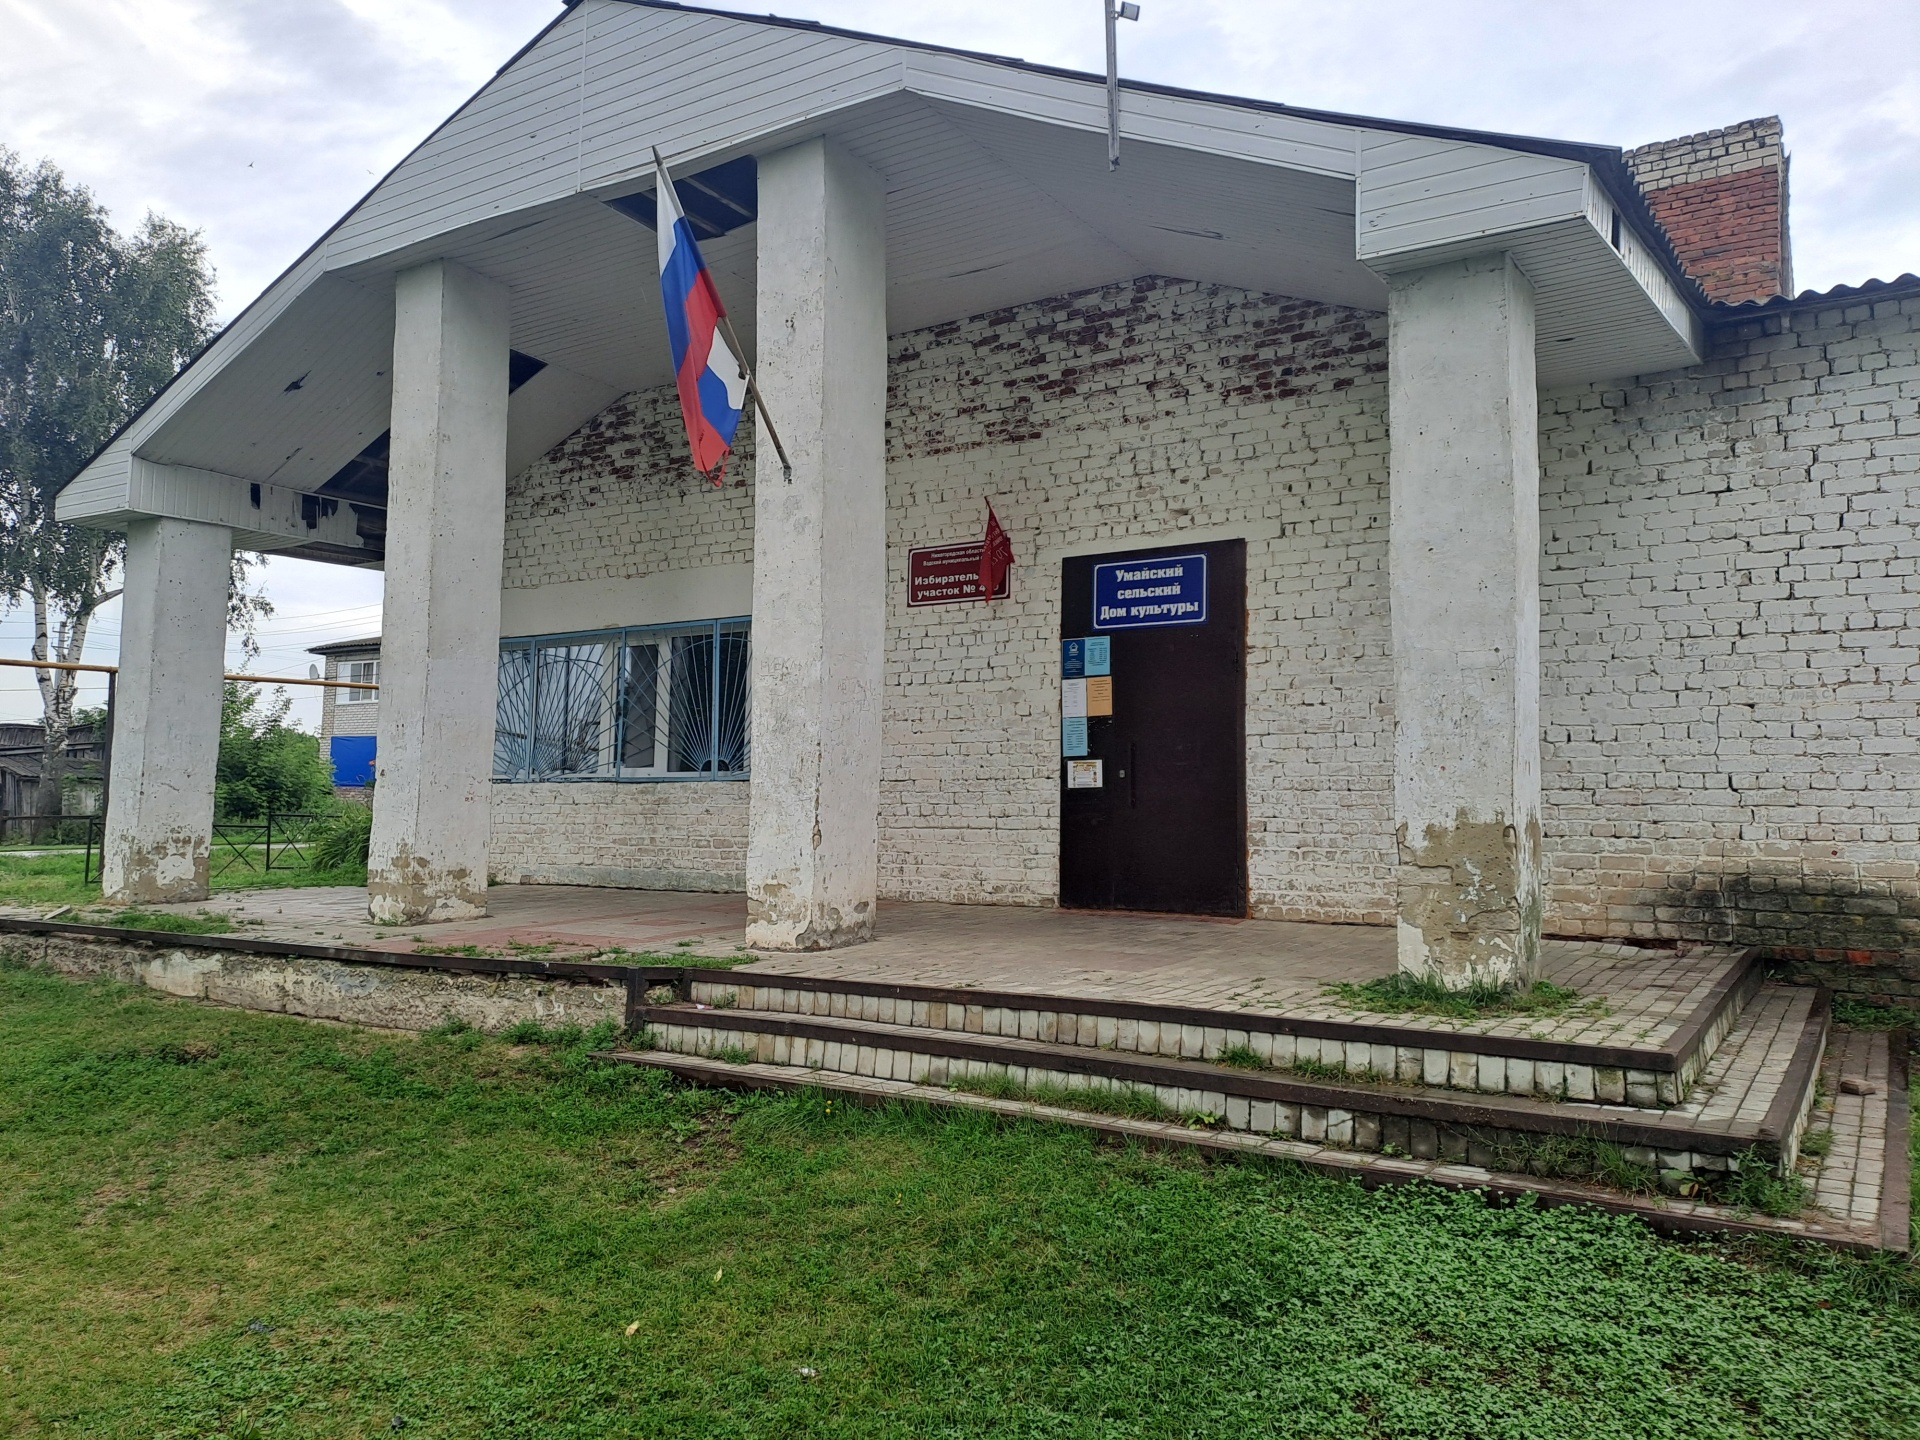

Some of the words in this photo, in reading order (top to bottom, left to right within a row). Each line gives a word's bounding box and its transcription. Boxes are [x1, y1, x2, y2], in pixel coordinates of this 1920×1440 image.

[914, 573, 979, 586] Избиратель
[1115, 564, 1184, 582] Умайский
[917, 586, 960, 600] участок
[963, 584, 976, 594] №
[1117, 582, 1181, 600] сельский
[1100, 605, 1127, 620] Дом
[1130, 601, 1199, 618] культуры
